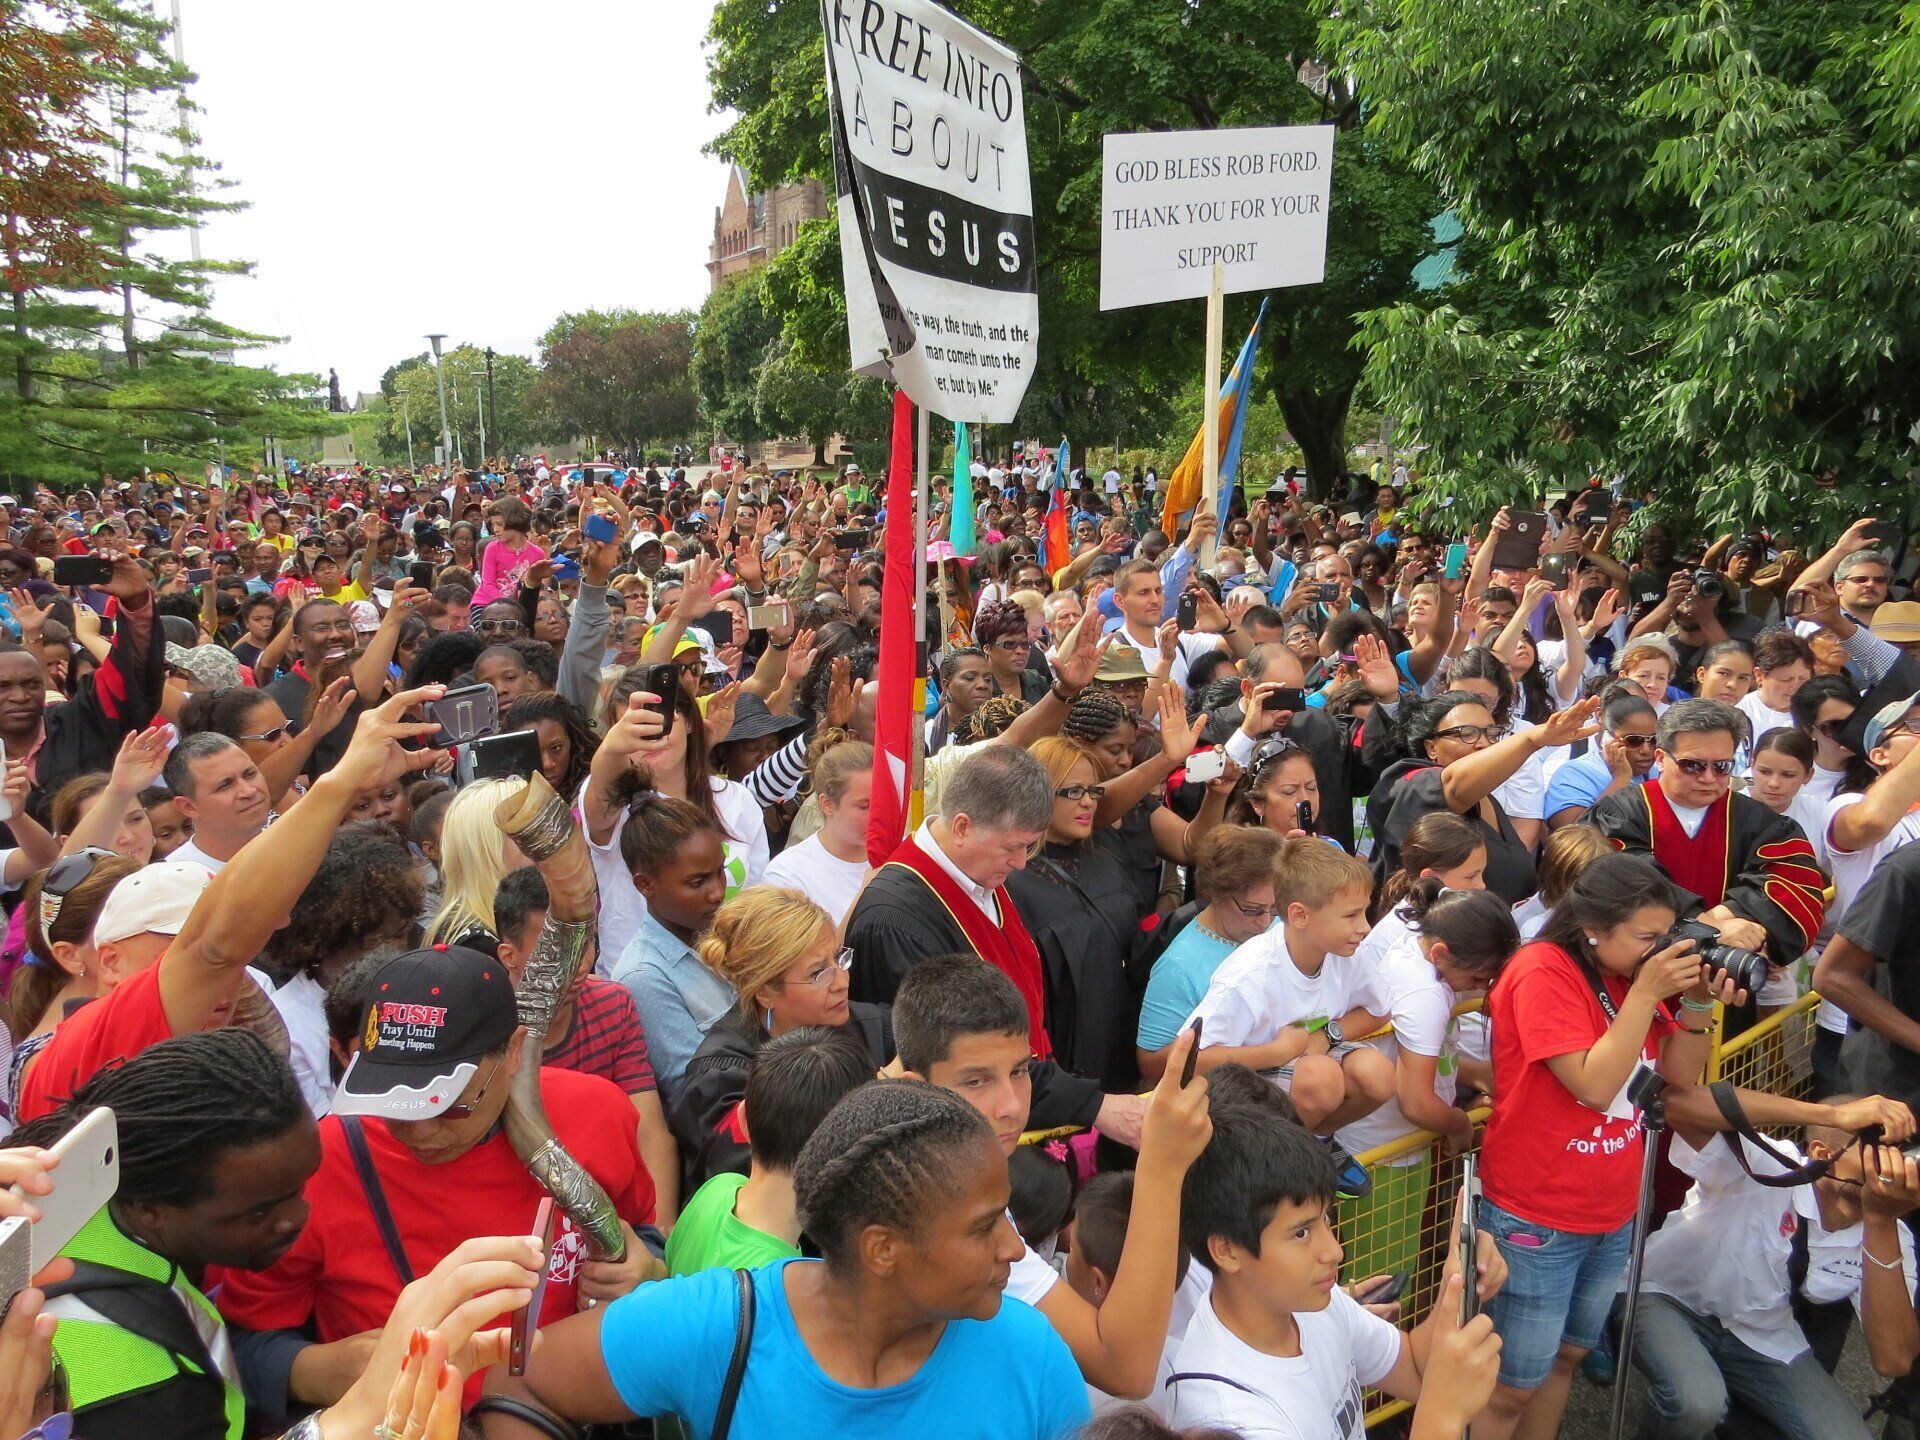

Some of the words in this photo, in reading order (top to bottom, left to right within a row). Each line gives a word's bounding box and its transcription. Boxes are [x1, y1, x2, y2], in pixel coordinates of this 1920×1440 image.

[833, 0, 931, 84] FREE
[942, 39, 1013, 123] INFO
[854, 84, 1005, 193] ABOUT
[1115, 161, 1159, 184] GOD
[1164, 156, 1221, 181] BLESS
[1226, 154, 1264, 177] ROB
[1269, 151, 1321, 174] FORD.
[1112, 204, 1181, 231] THANK
[1185, 201, 1225, 224] YOU
[1230, 198, 1266, 220] FOR
[1271, 194, 1321, 217] YOUR
[863, 184, 1021, 274] JESUS
[1177, 241, 1258, 269] SUPPORT
[922, 314, 943, 335] way,
[944, 314, 960, 334] the
[962, 319, 986, 342] truth,
[988, 324, 1007, 342] and
[1010, 324, 1029, 343] the
[924, 345, 945, 361] man
[946, 348, 979, 366] cometh
[980, 353, 1001, 369] unto
[1002, 352, 1021, 370] the
[934, 376, 949, 395] er,
[949, 373, 965, 394] but
[966, 375, 977, 398] by
[380, 1002, 448, 1027] PUSH
[382, 1022, 404, 1039] Pray
[406, 1024, 437, 1039] Until
[378, 1036, 406, 1051] Something
[406, 1038, 436, 1052] Happens
[383, 1099, 428, 1110] JESUS
[1566, 1138, 1598, 1154] For
[1601, 1136, 1626, 1155] the
